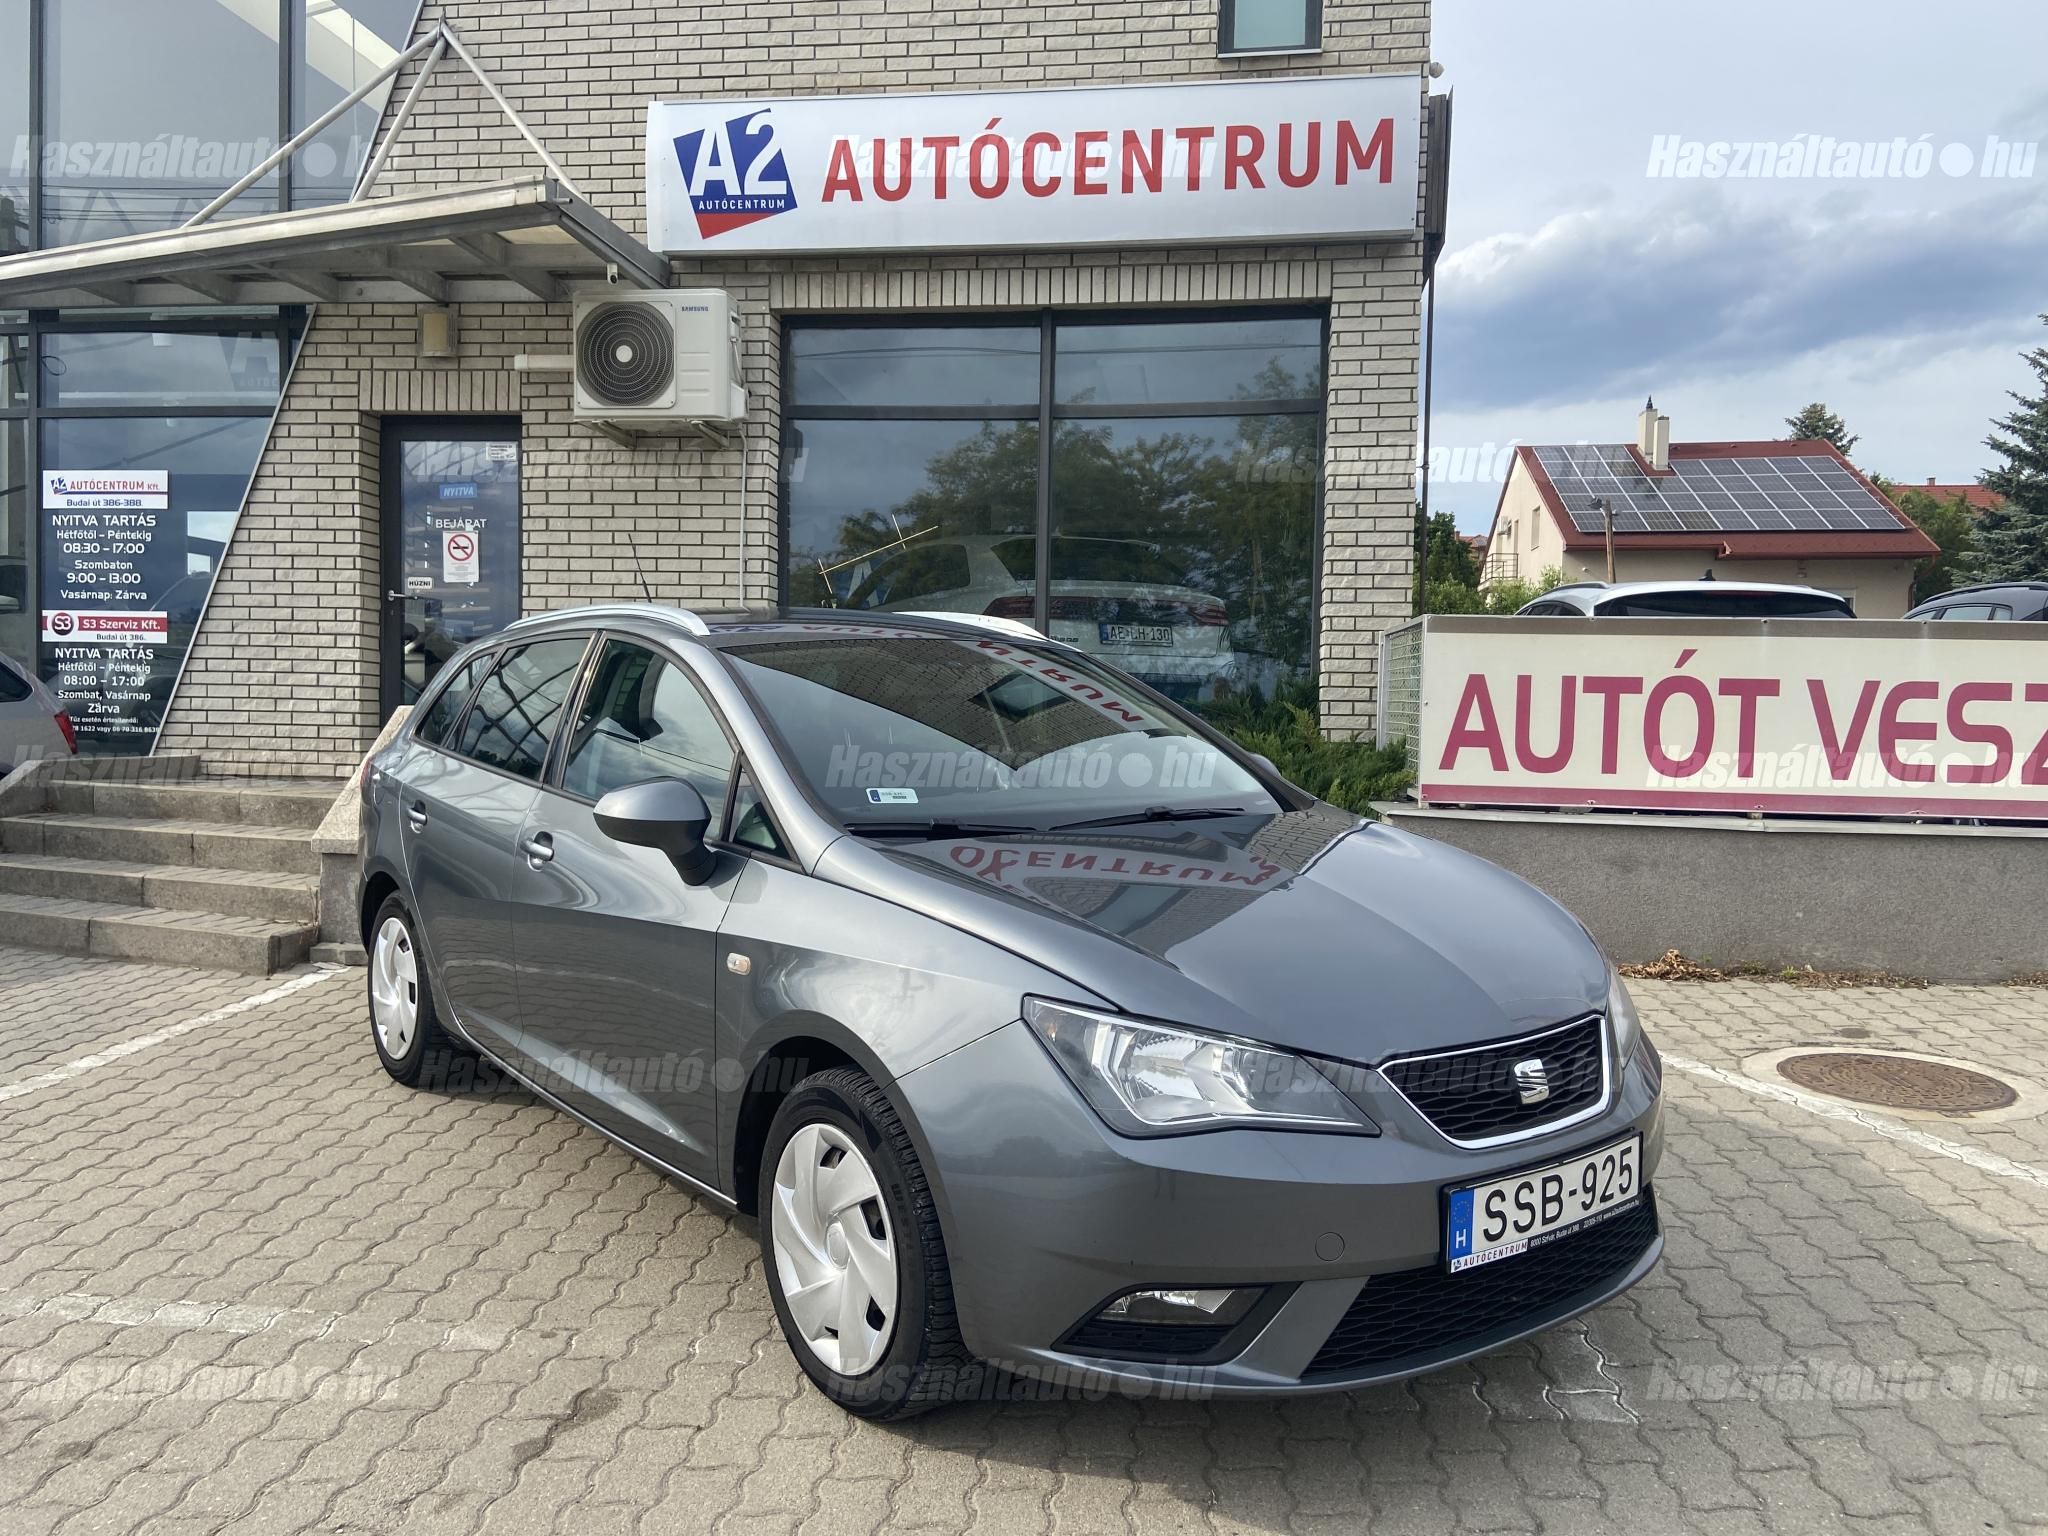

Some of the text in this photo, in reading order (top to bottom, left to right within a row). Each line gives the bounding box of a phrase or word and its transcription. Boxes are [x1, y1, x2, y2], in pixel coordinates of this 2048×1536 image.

[689, 110, 787, 196] A2
[821, 117, 1396, 203] AUTÓCENTRUM
[699, 198, 785, 210] AUTÓCENTRUM
[443, 487, 474, 497] NYITVA
[52, 512, 157, 527] NYITVA TARTÁS
[435, 516, 488, 529] BEJÁRAT
[57, 530, 97, 540] Hétfőtől
[108, 530, 152, 542] Péntekig
[63, 543, 100, 553] 08:30
[113, 543, 145, 554] 17:00
[75, 560, 133, 570] Szombaton
[67, 573, 97, 584] 9:00
[109, 573, 141, 584] 13:00
[115, 589, 147, 600] Zárva
[83, 619, 161, 630] S3 Szerviz Kft.
[55, 645, 154, 660] NYITVA TARTÁS
[58, 662, 97, 672] Hétfőtől
[109, 663, 151, 674] Péntekig
[63, 675, 97, 686] 08:00
[112, 676, 145, 687] 17:00
[58, 690, 151, 702] Szombat, Vasárnap
[88, 703, 120, 714] Zárva
[1439, 649, 1781, 778] AUTÓT
[1483, 1145, 1633, 1243] SSB-925
